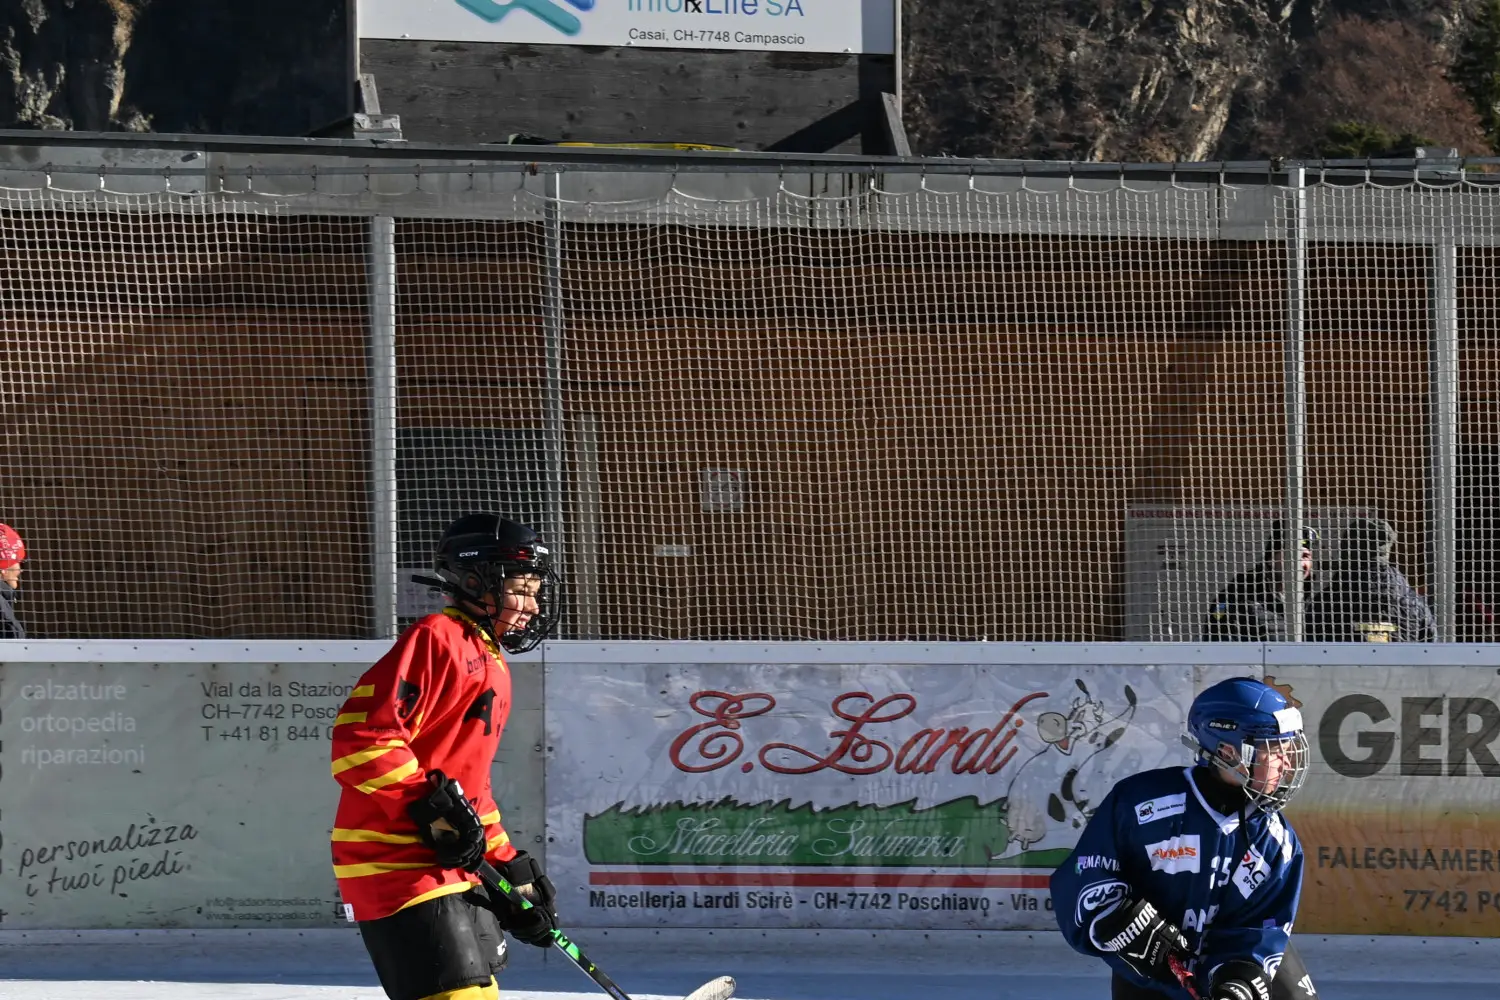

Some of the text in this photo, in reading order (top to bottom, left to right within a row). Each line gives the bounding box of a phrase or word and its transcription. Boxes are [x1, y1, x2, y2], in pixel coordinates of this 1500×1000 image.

[628, 28, 805, 45] Casai, CH-7748 Campascio
[201, 682, 233, 697] Vial
[239, 682, 261, 697] da
[268, 682, 282, 697] la
[20, 711, 137, 738] ortopedia
[201, 726, 214, 741] T
[220, 726, 251, 741] +41
[259, 726, 279, 741] 81
[287, 726, 319, 741] 844
[669, 689, 1050, 775] E. Lardi
[21, 744, 145, 769] riparazioni
[627, 817, 966, 858] Macelleria Salumeria
[18, 823, 199, 878] personalizza
[25, 874, 38, 897] i
[48, 863, 105, 894] tuoi
[589, 890, 686, 909] Macelleria
[693, 891, 740, 909] Lardi
[746, 891, 793, 909] Scirè
[814, 892, 891, 910] CH-7742
[898, 893, 990, 911] Poschiavo
[1010, 893, 1038, 911] Via
[1403, 889, 1468, 914] 7742
